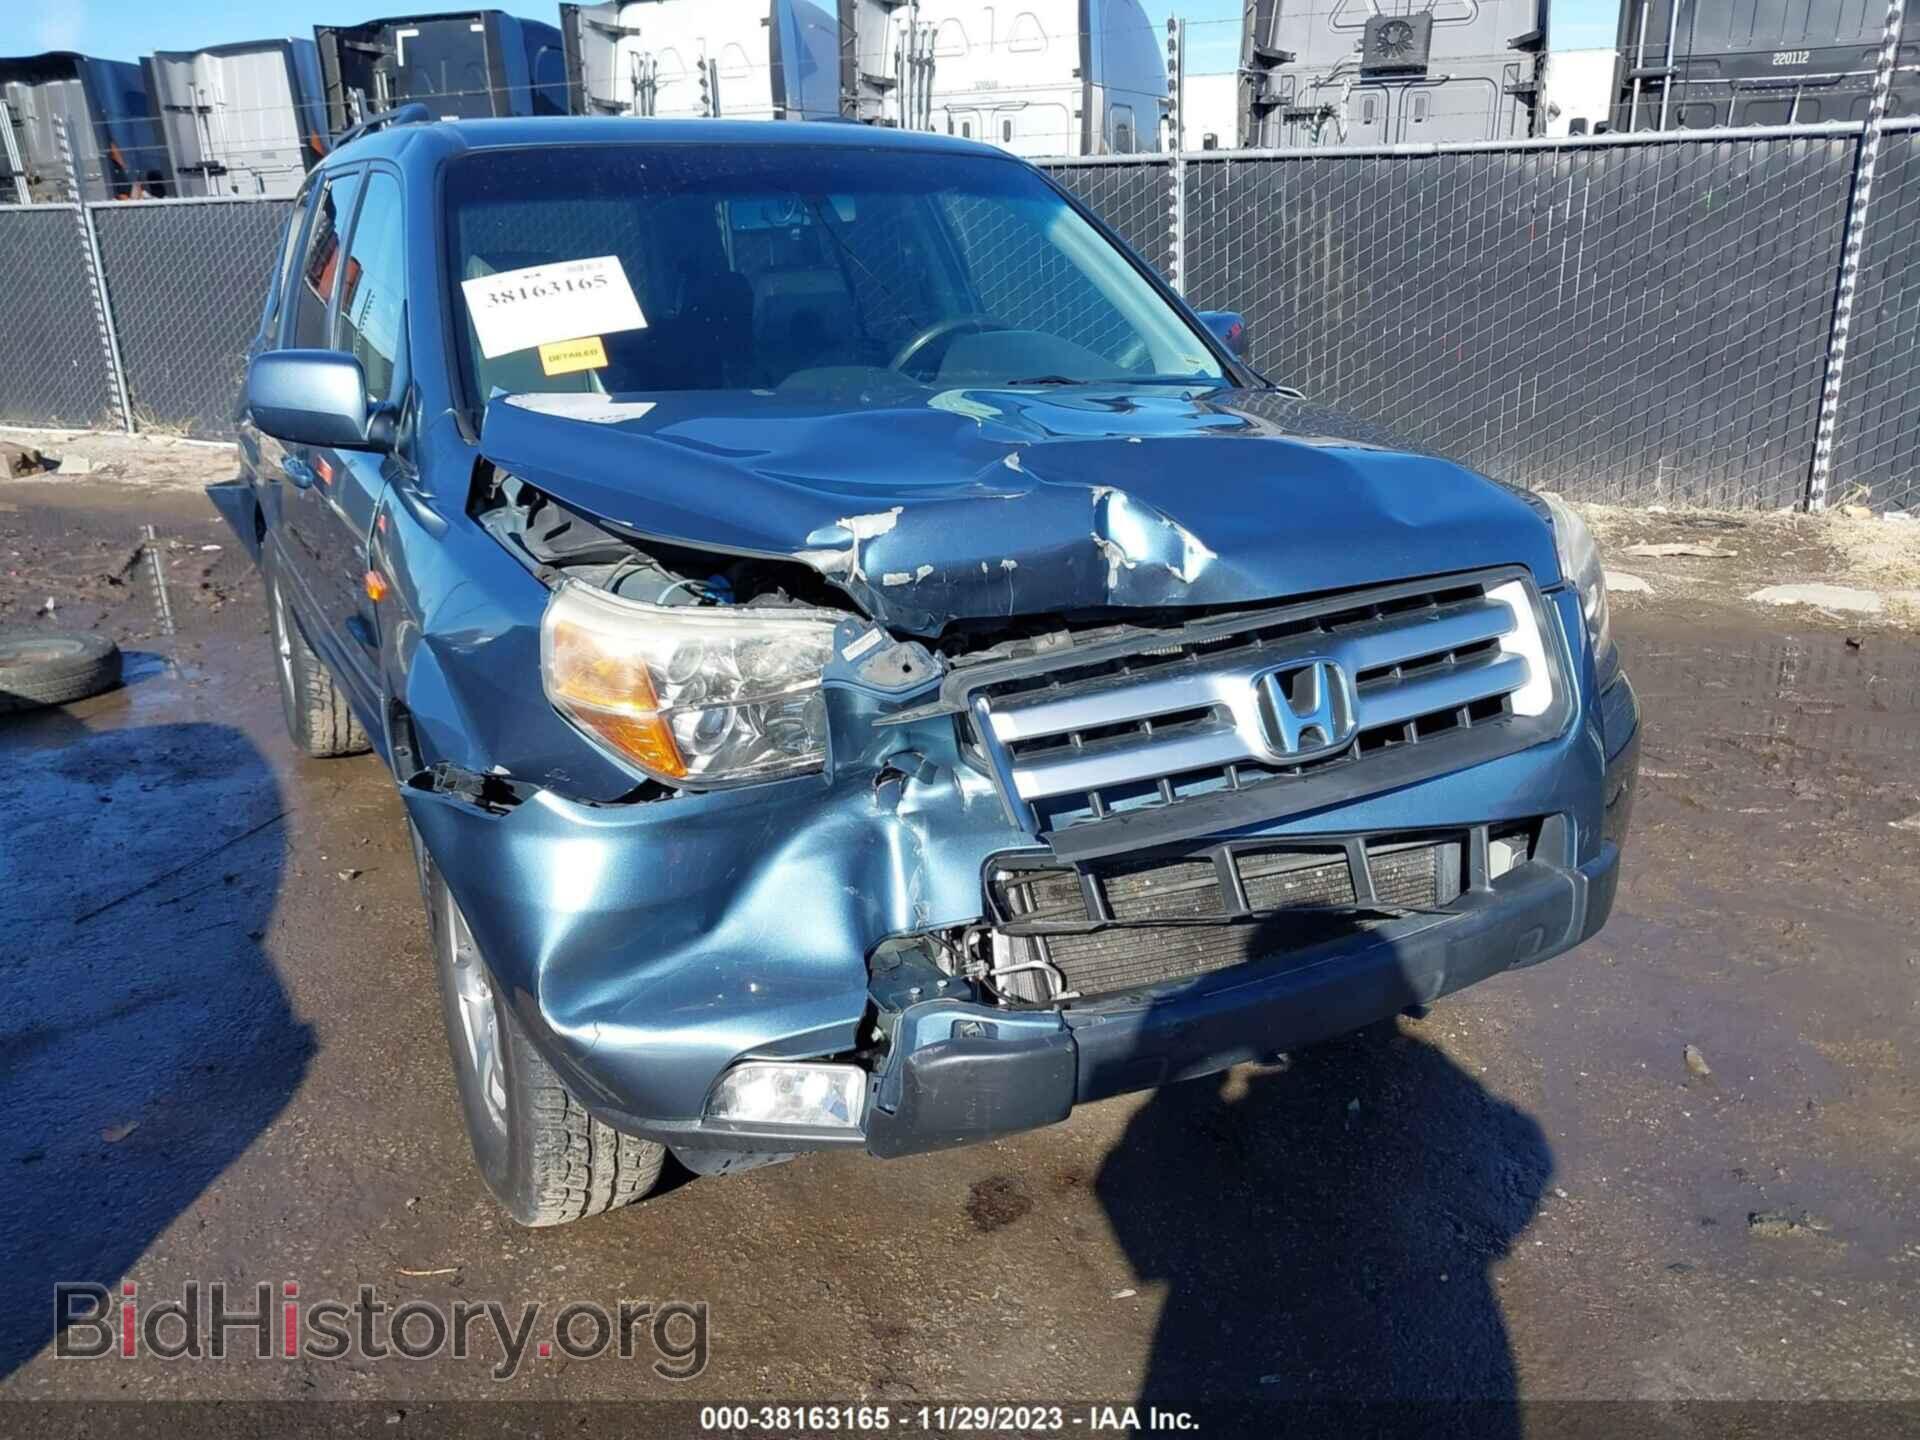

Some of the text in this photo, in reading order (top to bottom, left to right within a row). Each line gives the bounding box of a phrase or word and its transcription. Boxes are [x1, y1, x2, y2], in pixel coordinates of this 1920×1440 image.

[1772, 51, 1810, 65] 220112
[487, 274, 608, 308] 38163165
[548, 349, 599, 362] DETAILED
